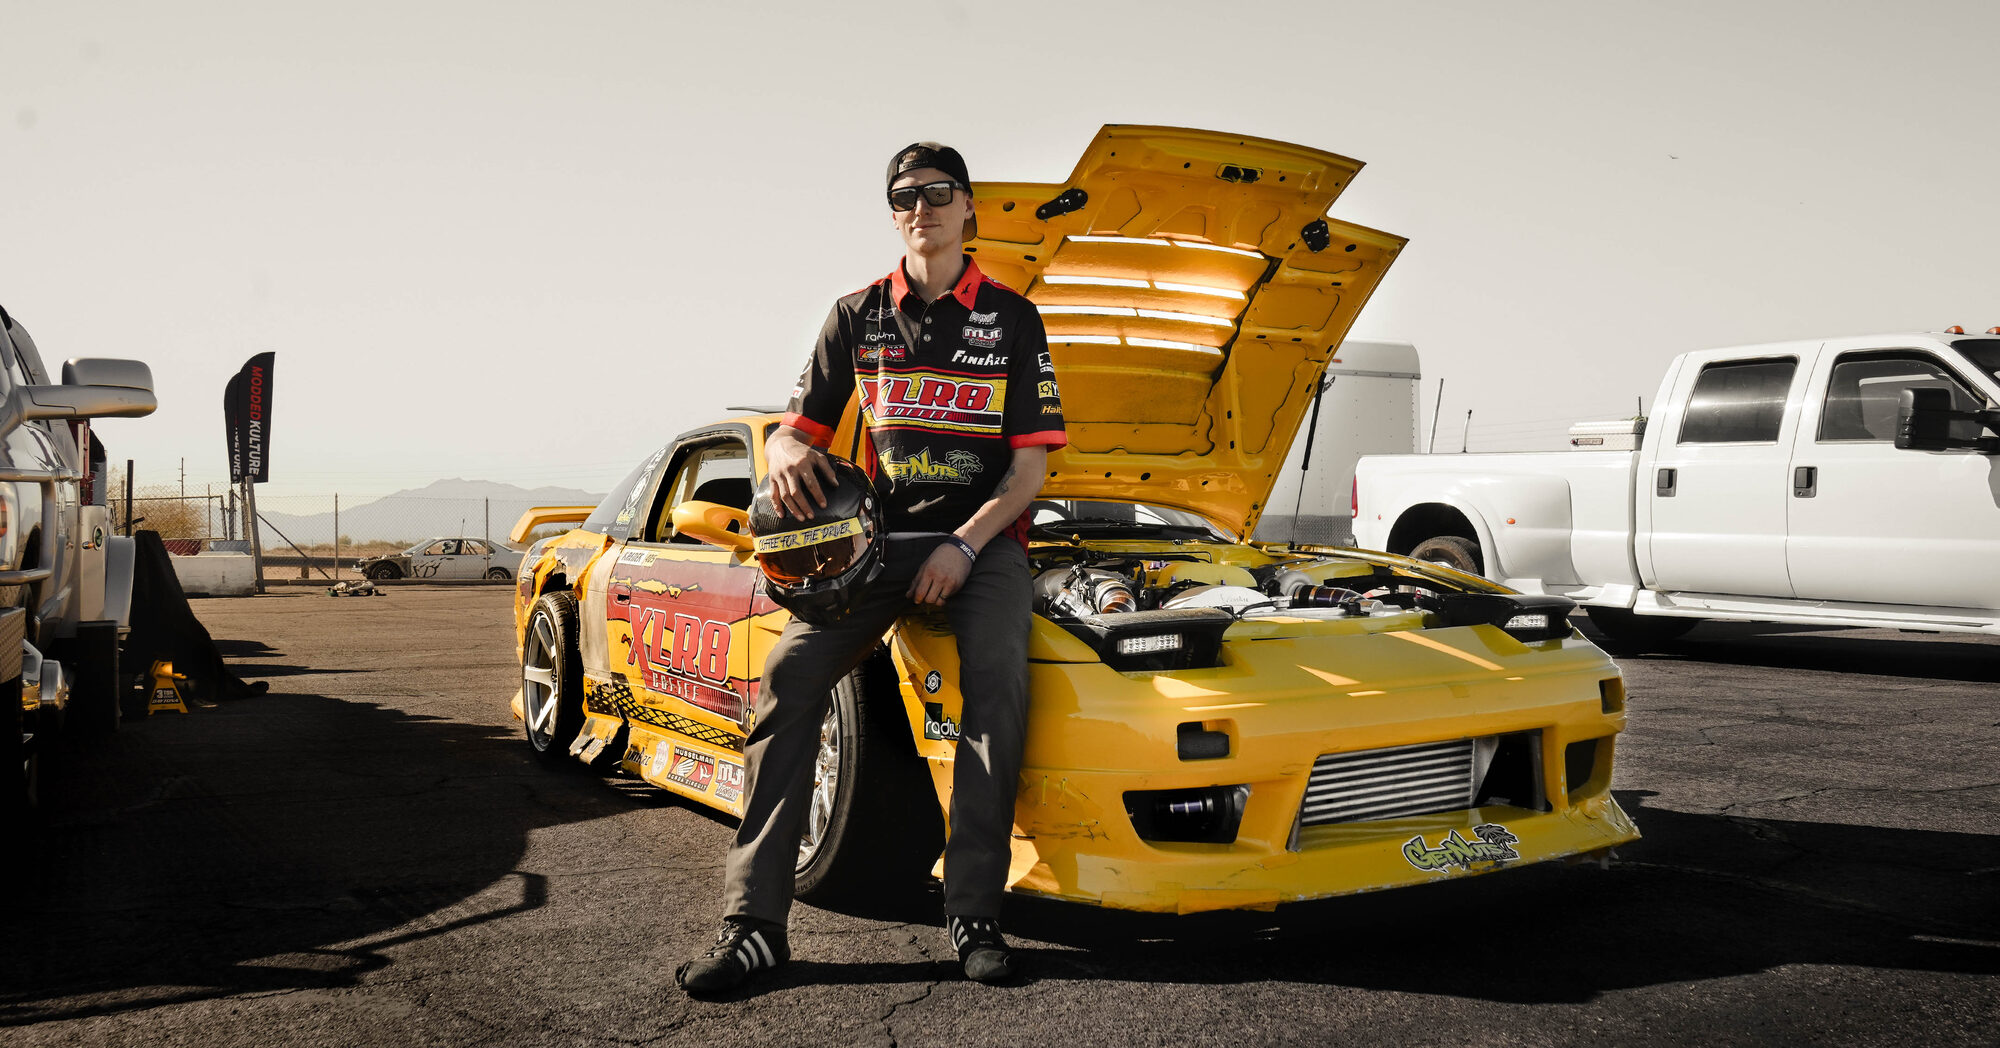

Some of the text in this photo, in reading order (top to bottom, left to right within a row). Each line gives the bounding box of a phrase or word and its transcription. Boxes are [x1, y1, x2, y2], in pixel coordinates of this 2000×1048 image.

[860, 376, 994, 421] XLR8
[883, 407, 954, 420] COFFEE
[801, 528, 819, 545] THE
[820, 521, 853, 539] DRIVER
[627, 604, 731, 688] XLR8
[652, 672, 699, 703] COFFEE
[926, 718, 961, 736] radiu
[675, 747, 714, 765] MUSSELMAN
